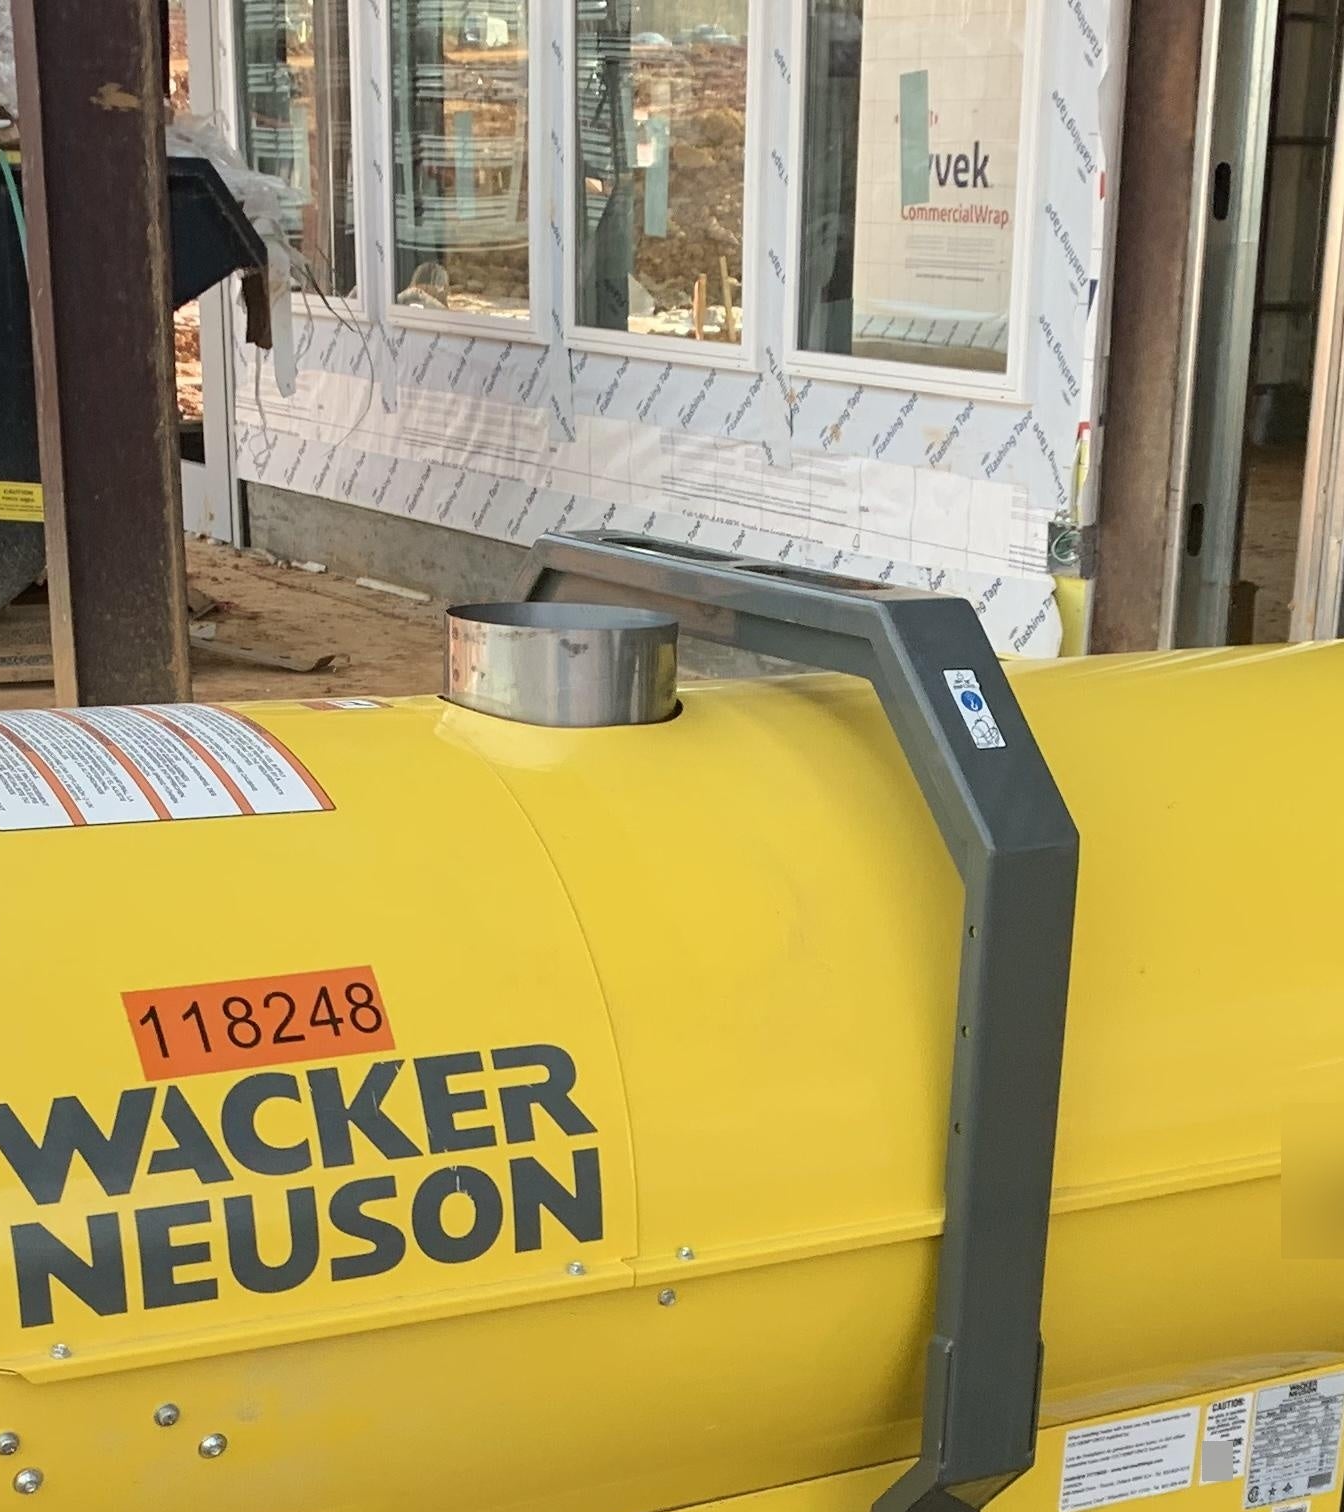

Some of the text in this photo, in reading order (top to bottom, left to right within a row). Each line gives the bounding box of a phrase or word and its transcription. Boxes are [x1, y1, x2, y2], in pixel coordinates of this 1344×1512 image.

[928, 140, 990, 189] vek
[1051, 90, 1095, 174] Flashing Tape
[901, 203, 1010, 229] CommercialWrap
[1044, 203, 1089, 287] Flashing Tape
[1038, 313, 1081, 398] Flashing Tape
[875, 392, 920, 459] Flashing Tape
[928, 400, 975, 469] Flashing Tape
[984, 410, 1033, 479] Flashing Tape
[1032, 422, 1049, 456] Tape
[982, 576, 1004, 602] Tape
[1013, 608, 1047, 653] Flashing
[138, 981, 383, 1059] 118248
[11, 1147, 604, 1329] NEUSON
